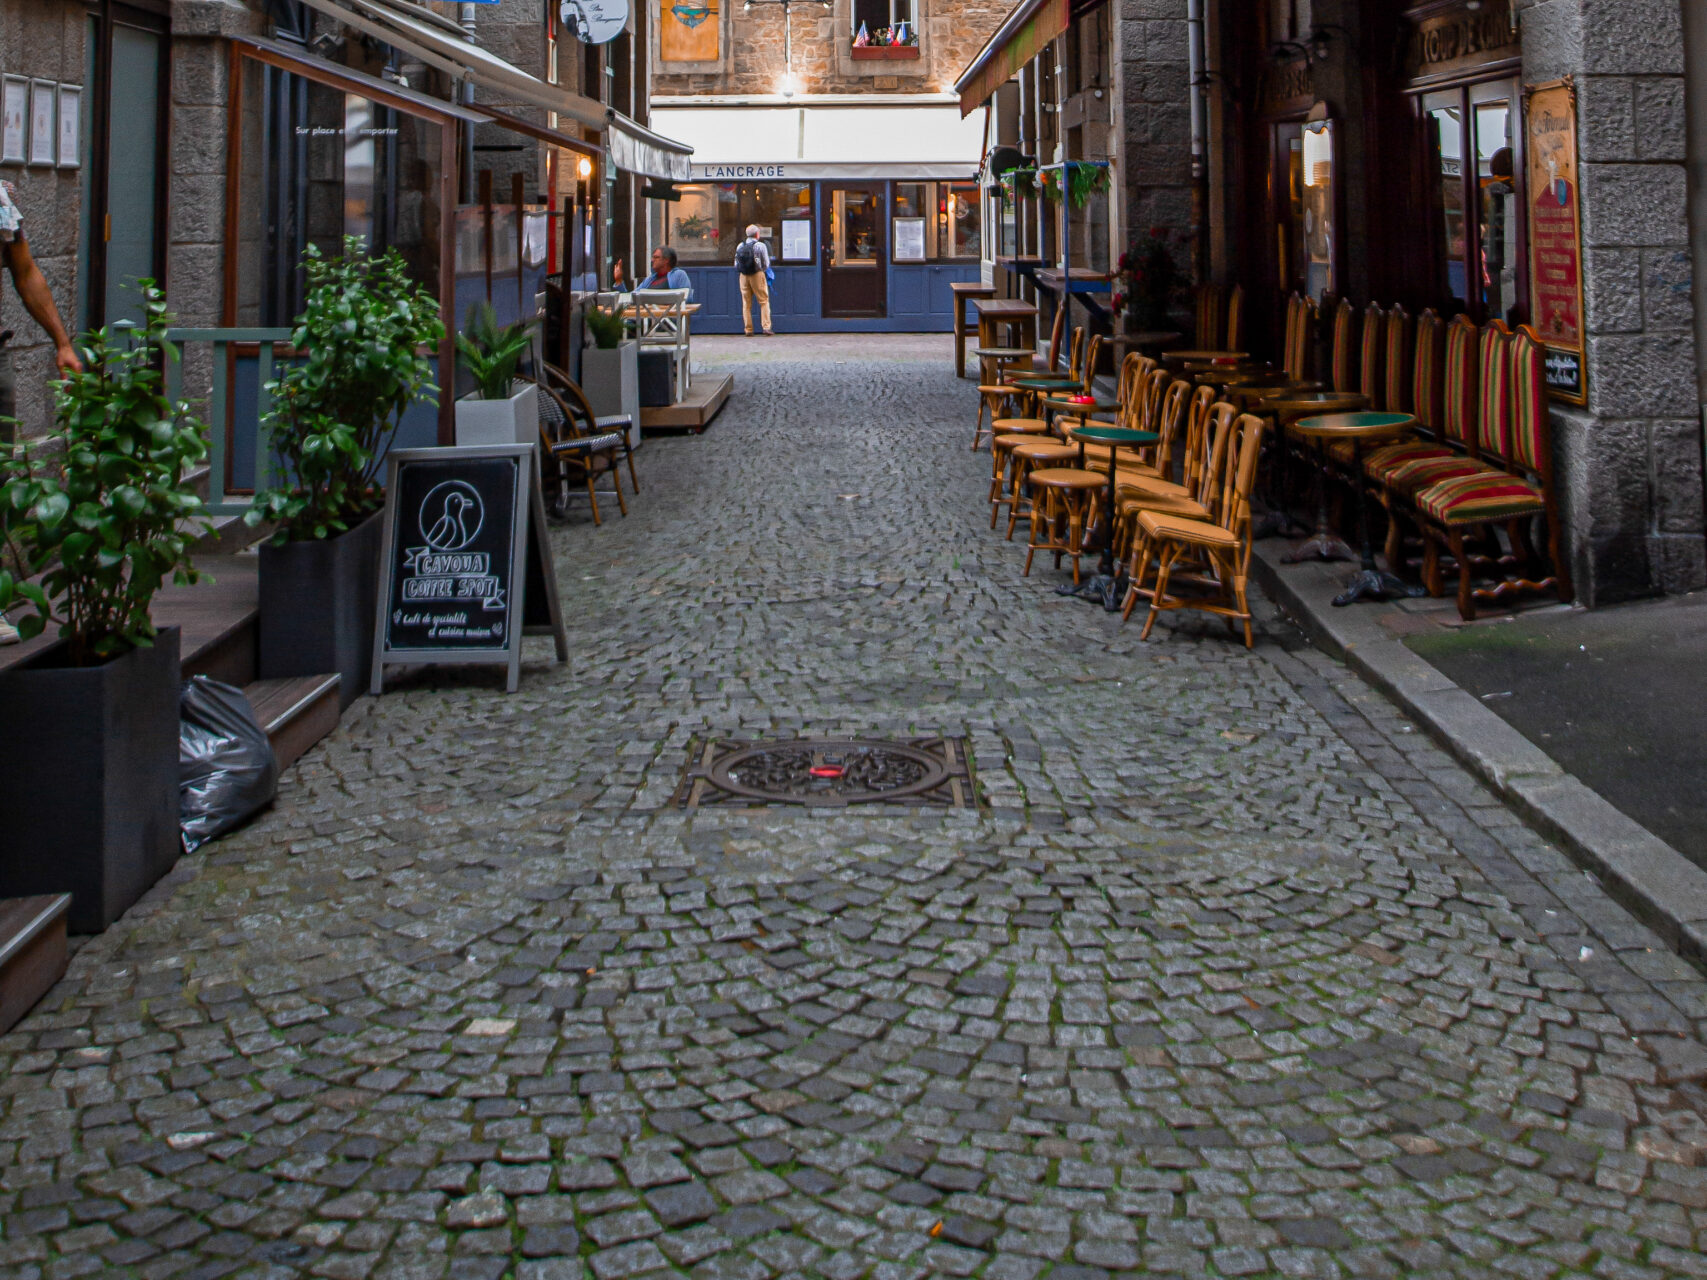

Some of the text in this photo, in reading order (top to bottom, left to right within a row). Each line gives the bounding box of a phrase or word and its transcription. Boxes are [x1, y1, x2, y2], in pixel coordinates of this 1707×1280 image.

[295, 126, 310, 135] Sur
[312, 126, 335, 137] place
[704, 166, 785, 177] L'ANCRAGE
[408, 577, 494, 598] COFFEE SPOT
